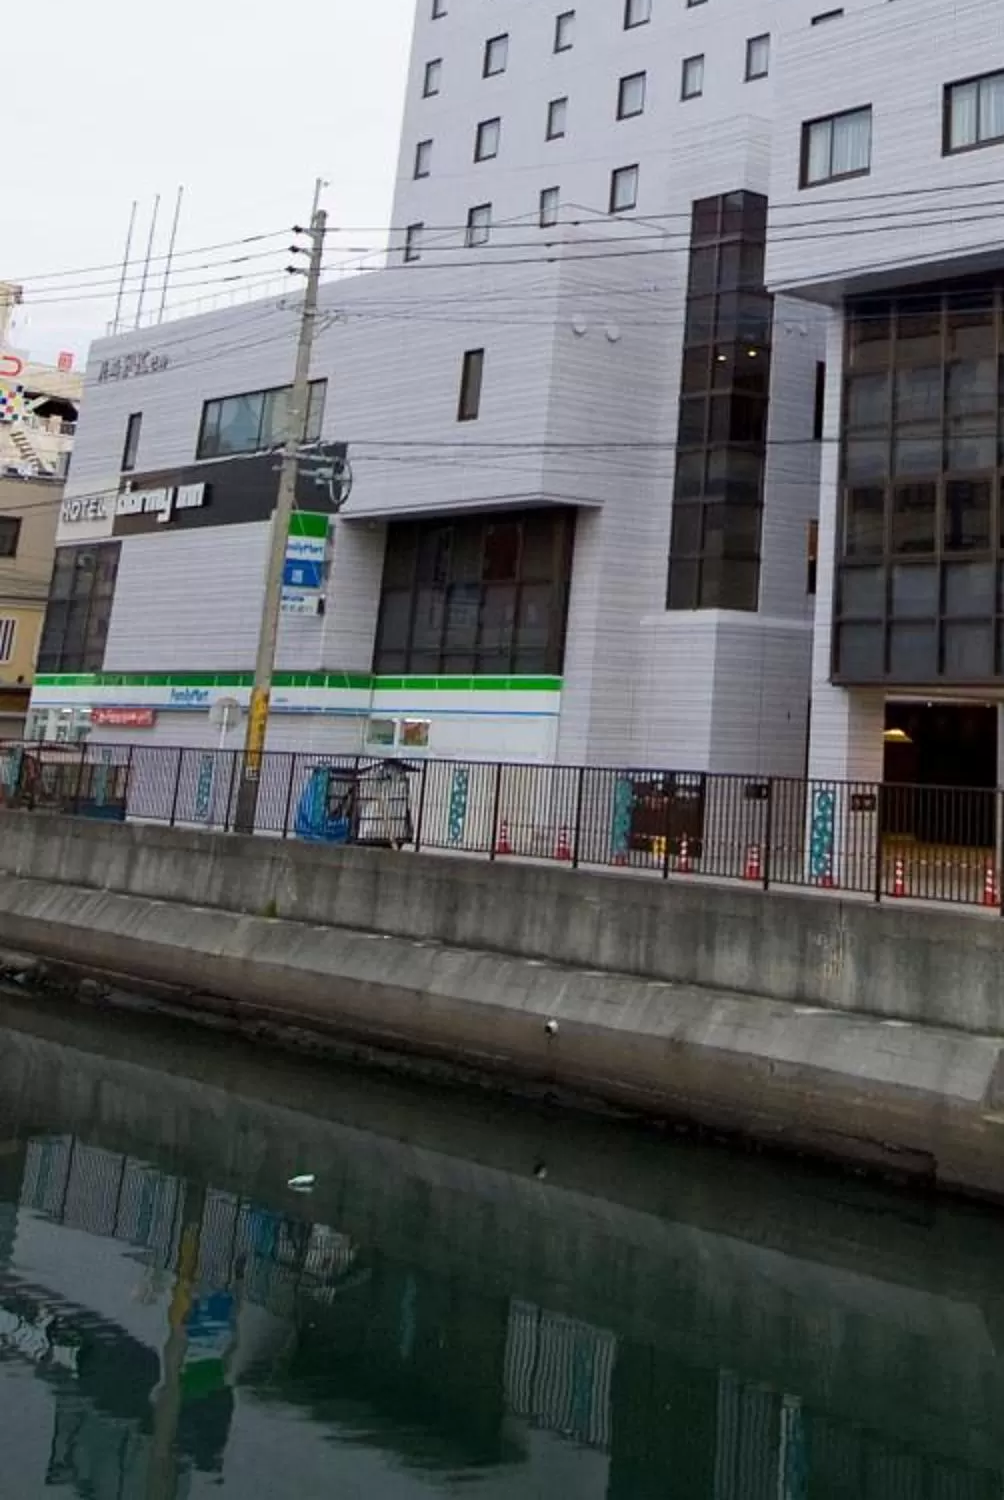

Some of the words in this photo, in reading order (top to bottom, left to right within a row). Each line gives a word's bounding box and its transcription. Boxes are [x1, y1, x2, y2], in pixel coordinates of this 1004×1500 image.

[63, 496, 108, 522] HOTEL
[115, 480, 174, 523] dormy
[175, 482, 206, 509] inn
